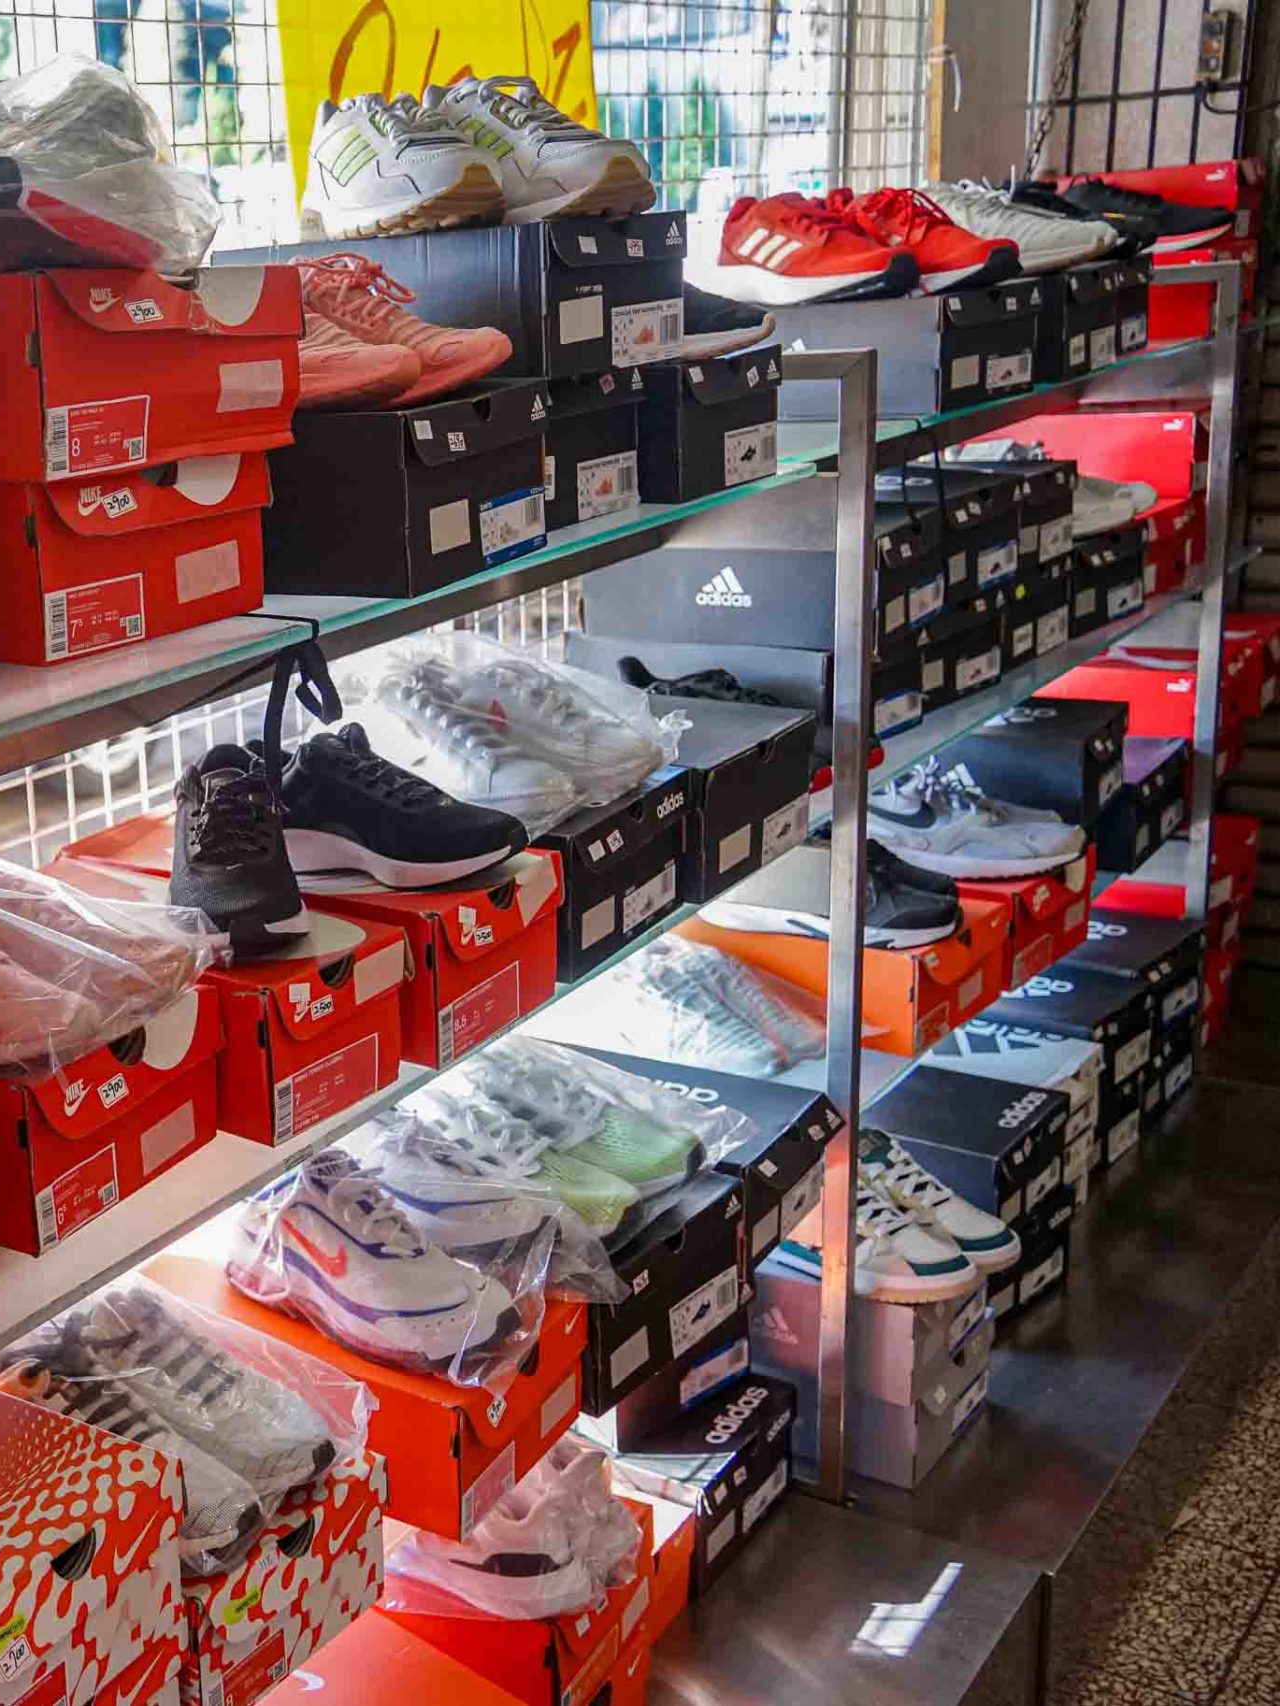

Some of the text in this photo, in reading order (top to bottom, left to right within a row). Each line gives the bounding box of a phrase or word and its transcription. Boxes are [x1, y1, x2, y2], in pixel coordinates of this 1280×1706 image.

[131, 304, 155, 322] 2900
[71, 437, 80, 457] 8
[107, 493, 131, 511] 2900
[695, 590, 752, 608] adidas
[656, 792, 684, 819] adidas
[314, 1001, 332, 1014] 2500
[103, 1079, 124, 1100] 2900
[705, 1387, 769, 1444] adidas
[2, 1643, 25, 1674] 2700
